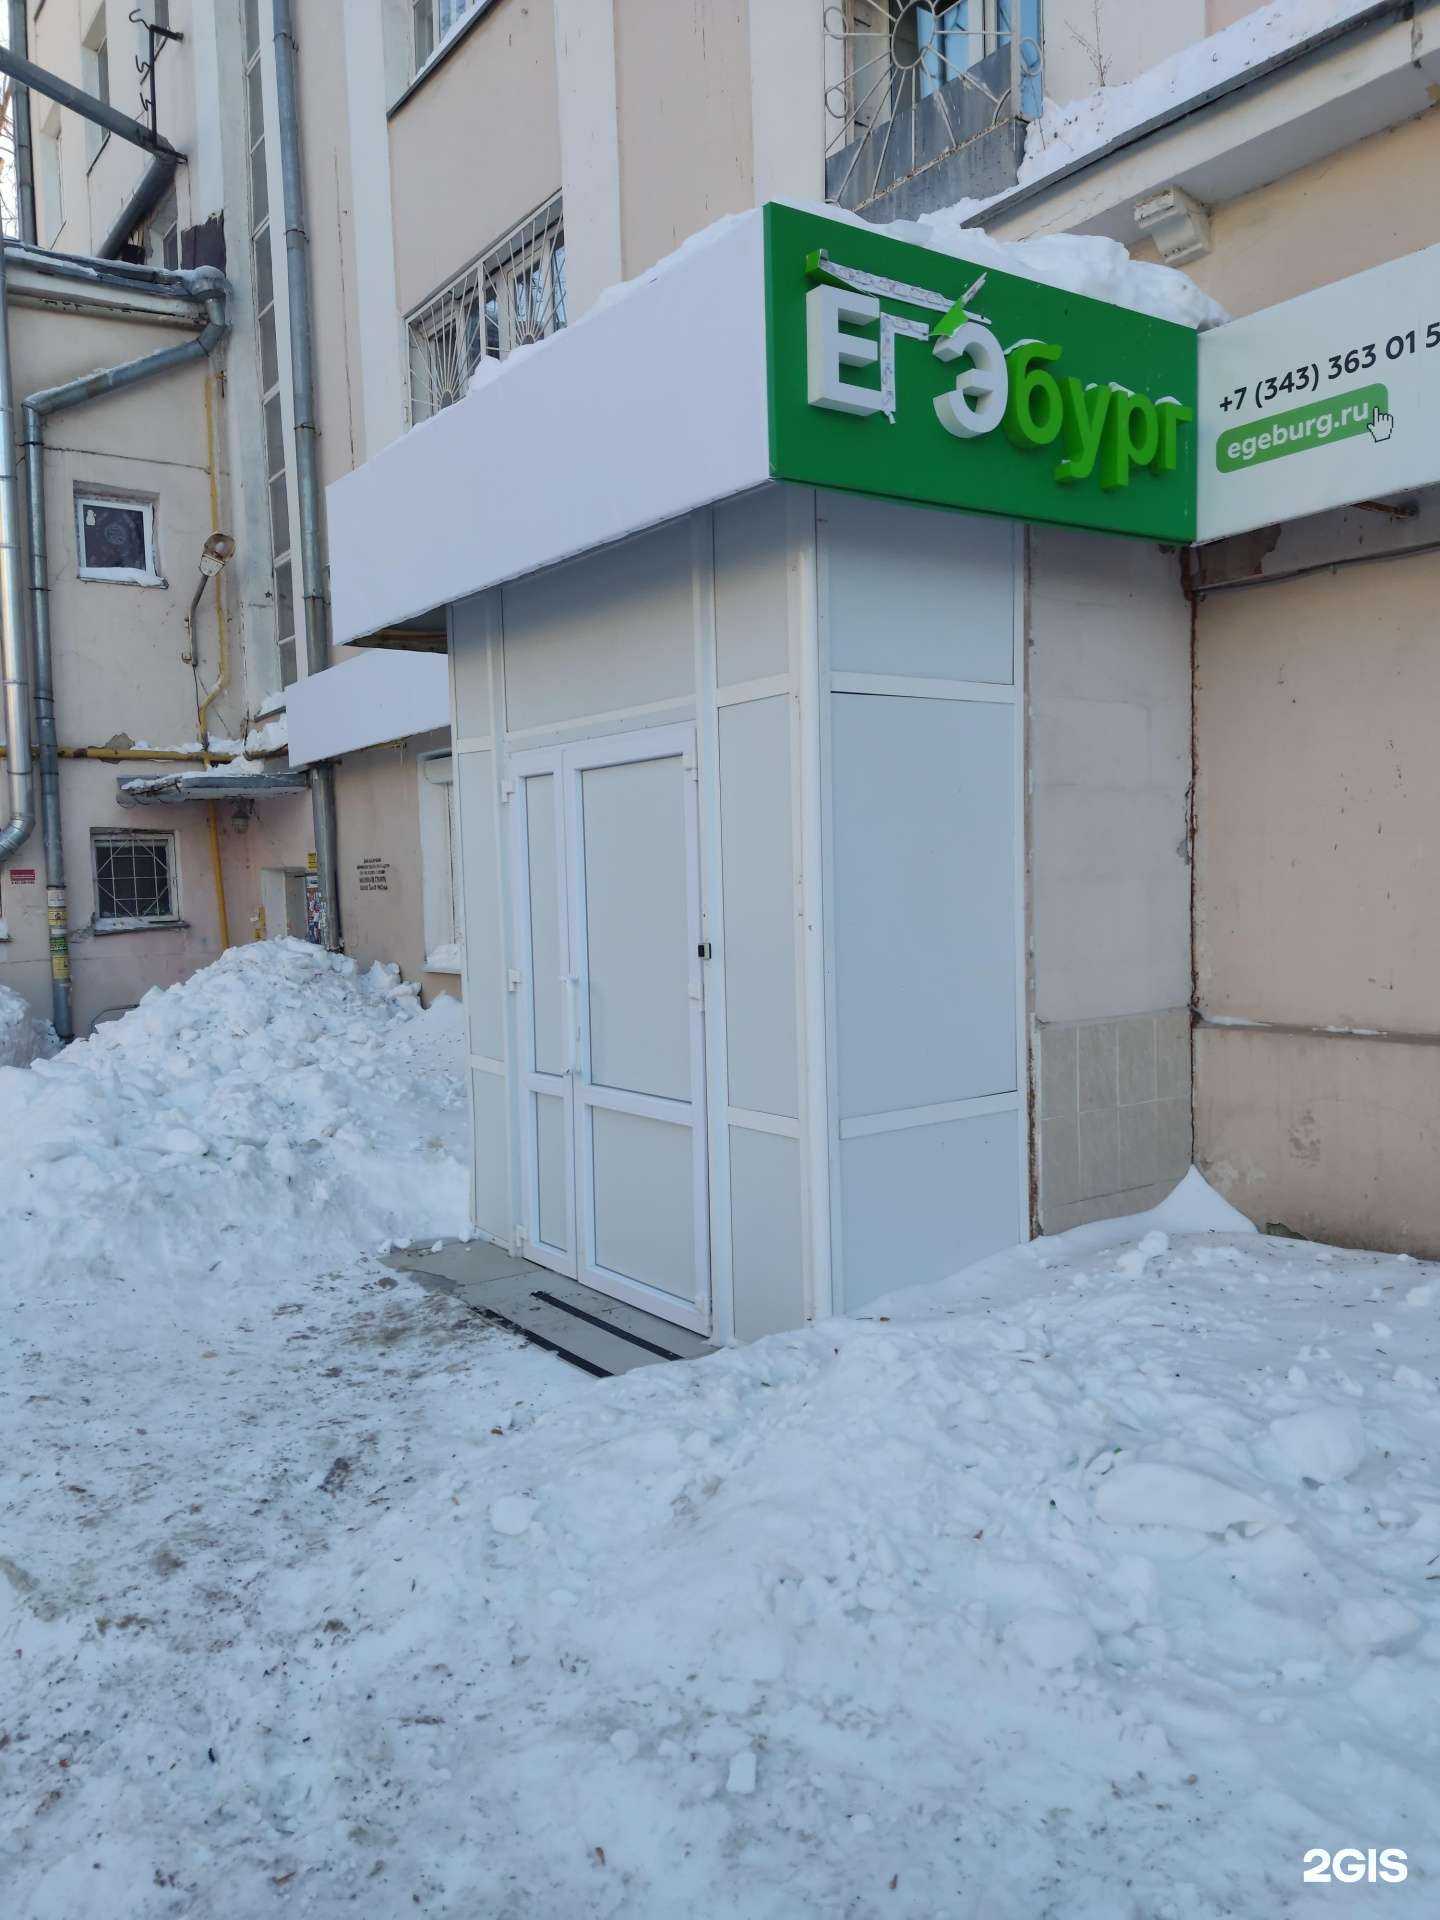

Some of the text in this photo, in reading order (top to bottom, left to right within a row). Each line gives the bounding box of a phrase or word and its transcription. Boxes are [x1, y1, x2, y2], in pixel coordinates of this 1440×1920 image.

[806, 284, 1192, 491] ЕГЭбург
[1219, 387, 1247, 412] +7
[1255, 363, 1319, 409] (343)
[1328, 344, 1377, 380] 363
[1385, 330, 1415, 360] 01
[1227, 402, 1369, 460] egeburg.ru
